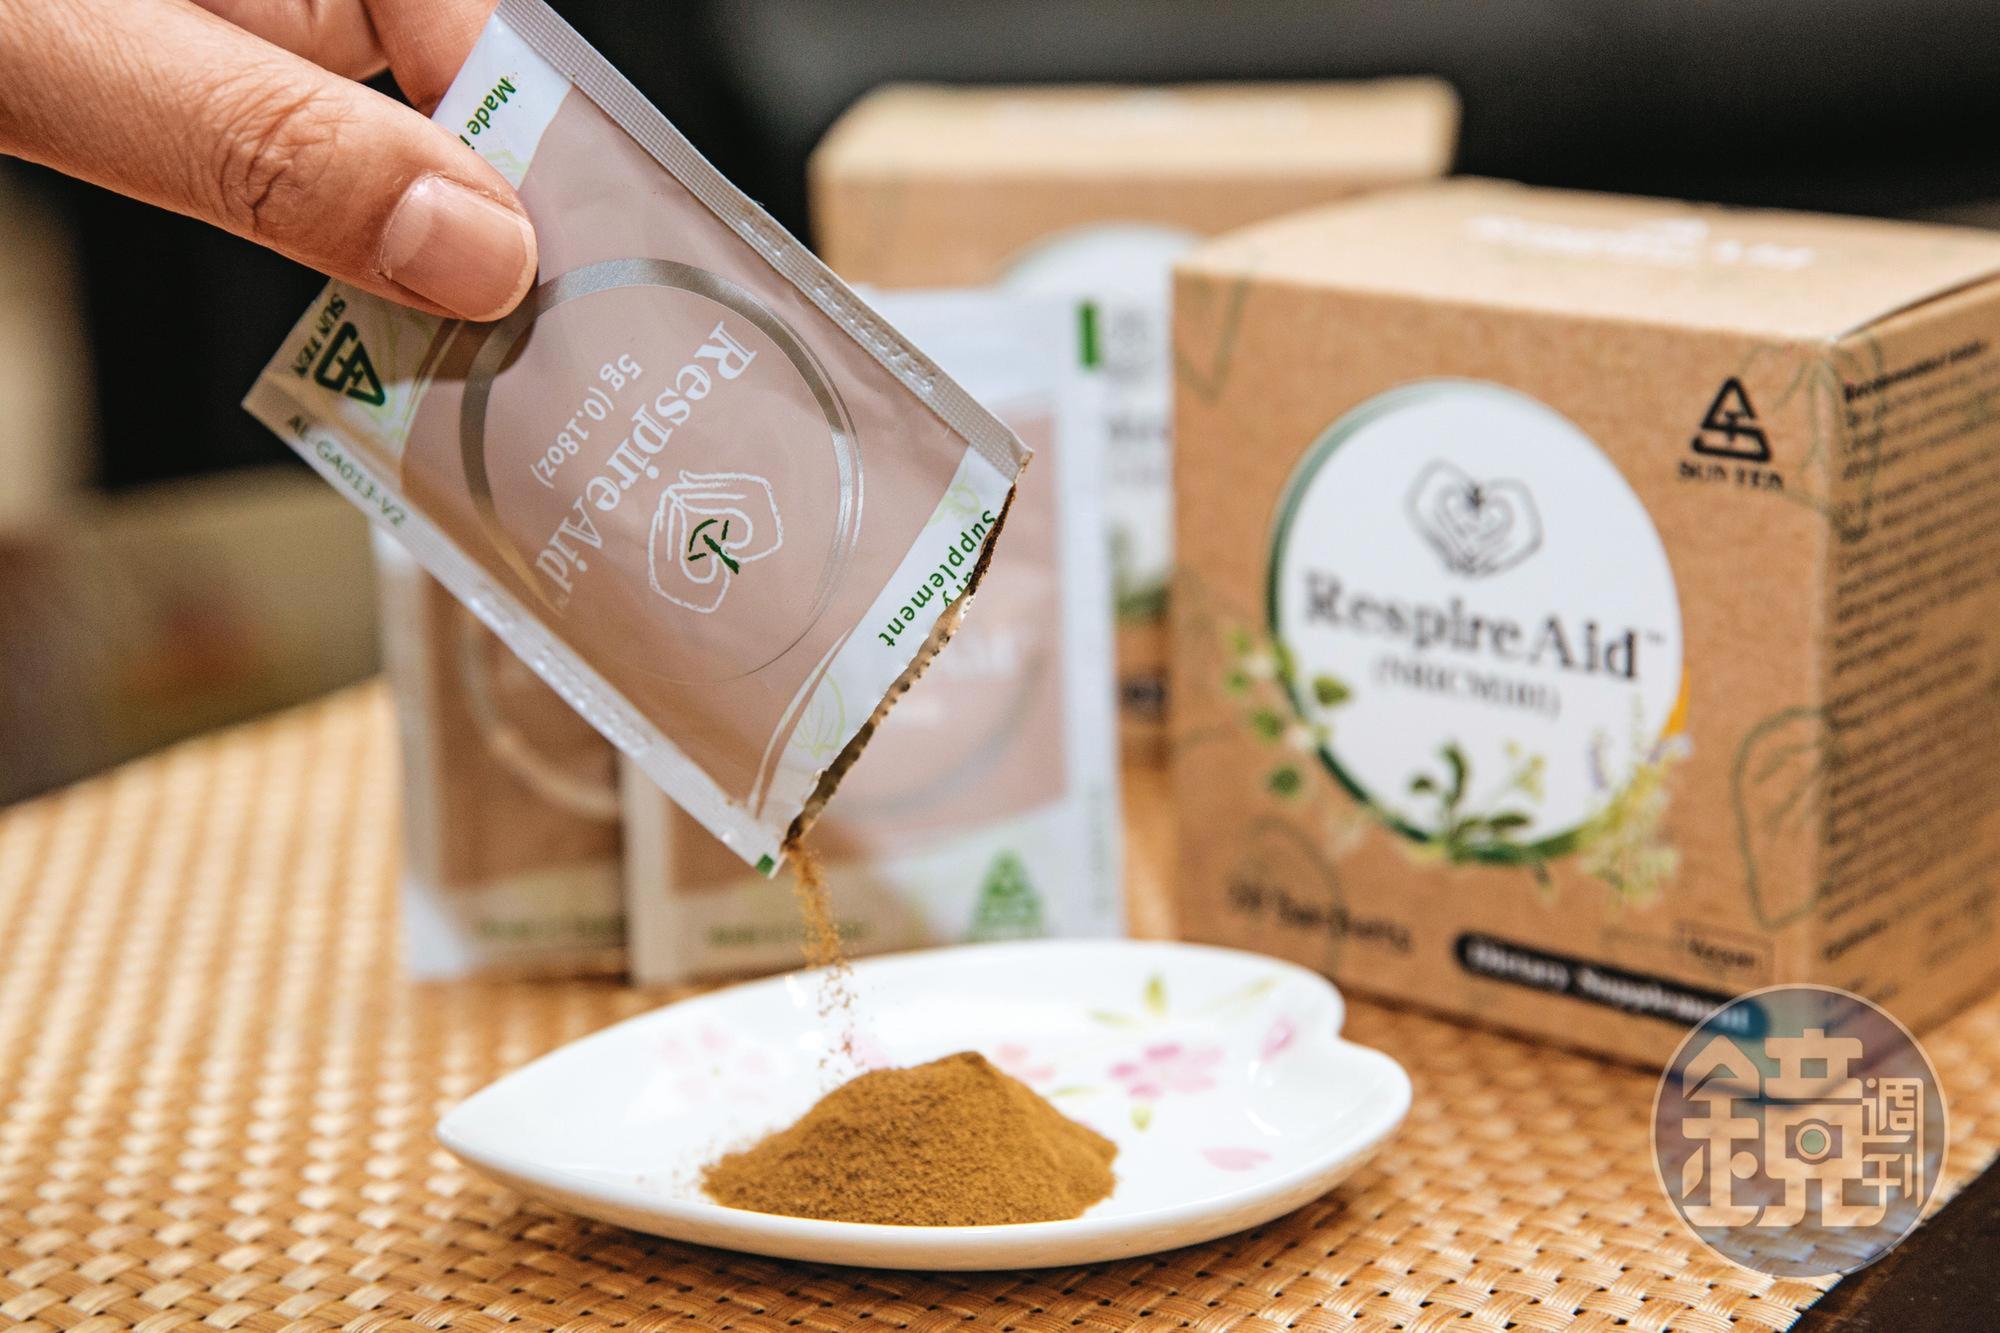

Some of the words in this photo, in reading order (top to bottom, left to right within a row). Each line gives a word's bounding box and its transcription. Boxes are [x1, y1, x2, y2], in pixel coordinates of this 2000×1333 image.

[466, 76, 517, 136] Made
[459, 134, 475, 151] i
[600, 353, 643, 392] 5g
[529, 386, 615, 489] (0.18oz)
[878, 509, 996, 647] Supplement
